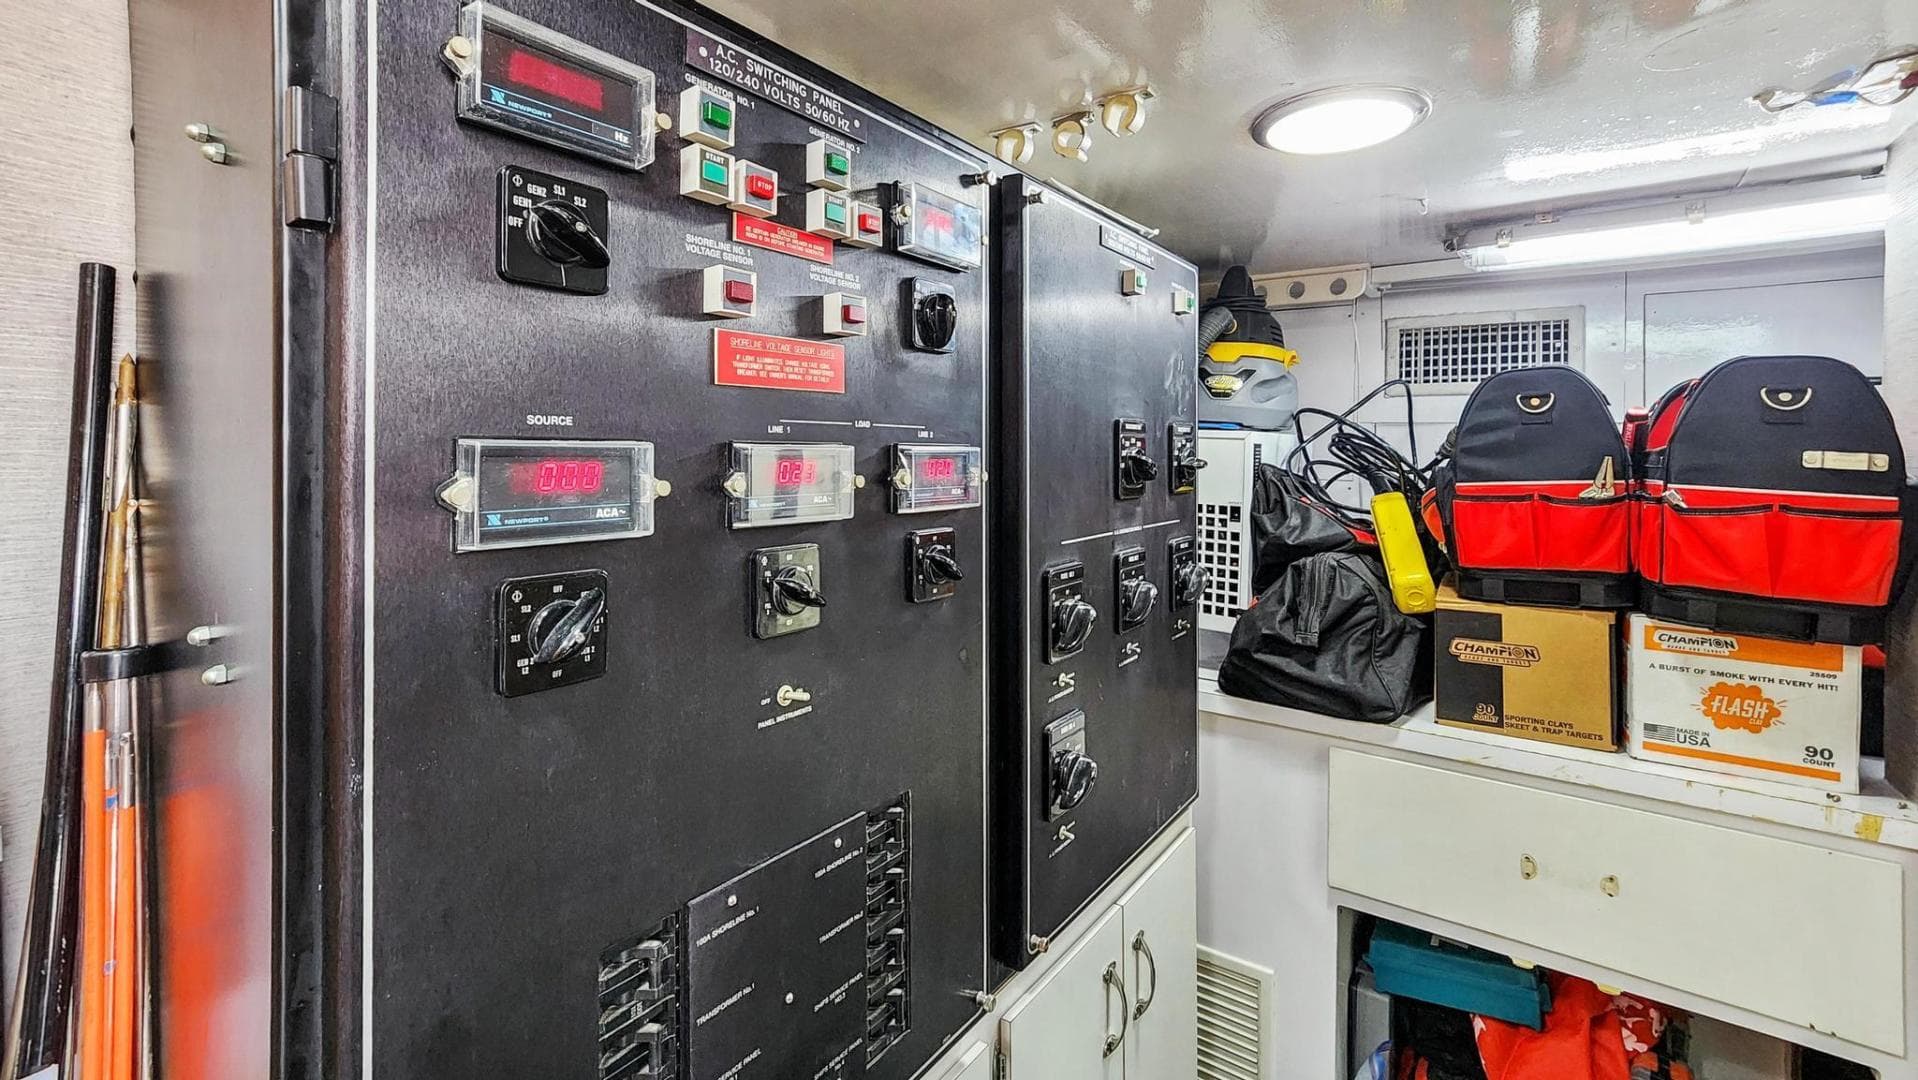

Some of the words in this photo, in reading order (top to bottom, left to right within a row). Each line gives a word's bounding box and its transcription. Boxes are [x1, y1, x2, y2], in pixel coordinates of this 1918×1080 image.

[716, 44, 739, 65] A.C.
[746, 59, 807, 97] SWITCHING
[812, 90, 845, 115] PANEL
[684, 72, 734, 101] GENERATOR
[737, 95, 750, 107] NO.
[750, 101, 755, 110] 1
[709, 58, 760, 90] 120/240
[763, 82, 800, 109] VOLTS
[805, 102, 836, 126] 50/60
[837, 116, 850, 132] HZ
[614, 131, 629, 144] Hz
[705, 152, 725, 164] START
[553, 184, 566, 196] SL1
[757, 180, 773, 192] STOP
[573, 195, 587, 208] SL2
[508, 215, 524, 228] OFF
[685, 234, 732, 252] SHORELINE
[732, 245, 747, 256] NO.
[747, 248, 751, 257] 1
[685, 243, 722, 260] VOLTAGE
[722, 252, 754, 266] SENSOR
[809, 264, 844, 280] SHORELINE
[809, 272, 837, 287] VOLTAGE
[837, 278, 861, 290] SENSOR
[526, 414, 573, 426] SOURCE
[767, 425, 784, 434] LINE
[786, 425, 791, 434] 1
[538, 462, 600, 491] 000
[1658, 633, 1737, 650] CHAMPION
[1454, 641, 1538, 660] CHAMPION
[1658, 663, 1691, 674] BURST
[1693, 667, 1707, 675] OF
[1709, 670, 1745, 681] SMOKE
[1748, 674, 1775, 684] WITH
[1778, 678, 1813, 689] EVERY
[1817, 683, 1839, 692] HIT!
[1476, 702, 1496, 716] 90
[1711, 695, 1770, 720] FLASH
[757, 717, 776, 730] PANEL
[1504, 714, 1545, 727] SPORTING
[1547, 719, 1574, 730] CLAYS
[1504, 721, 1530, 731] SKEET
[1541, 726, 1563, 736] TRAP
[1564, 729, 1604, 742] TARGETS
[1676, 727, 1701, 736] MADE
[1676, 735, 1712, 748] USA
[1804, 745, 1834, 761] 90
[1802, 757, 1836, 769] COUNT
[711, 913, 745, 938] SHORELINE
[696, 990, 743, 1027] TRANSFORMER
[743, 1047, 762, 1066] PANEL
